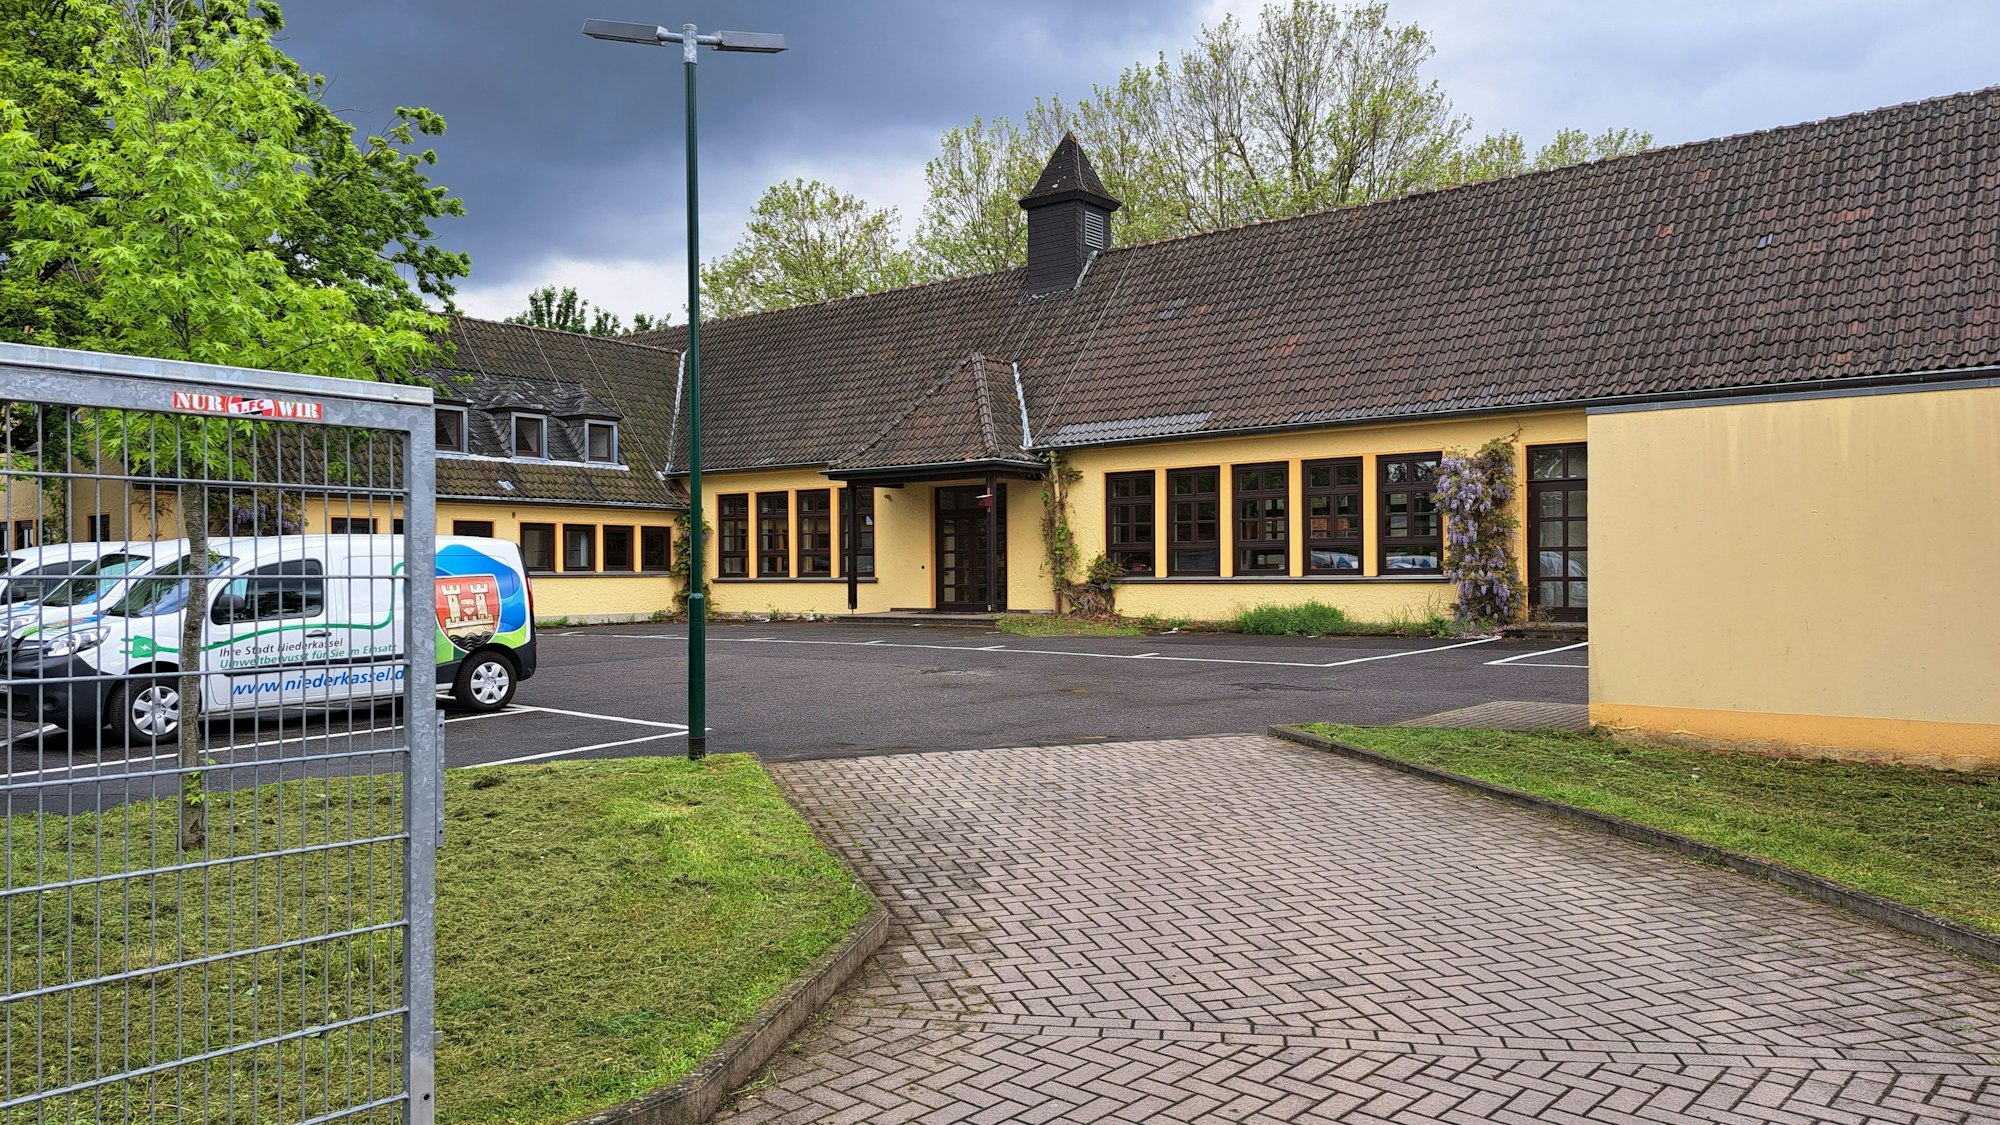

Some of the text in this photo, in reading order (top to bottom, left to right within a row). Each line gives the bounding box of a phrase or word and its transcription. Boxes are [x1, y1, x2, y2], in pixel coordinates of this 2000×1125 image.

[176, 391, 224, 411] NUR
[279, 400, 320, 419] WIR
[219, 647, 242, 658] Ihre
[245, 643, 274, 656] Stadt
[330, 648, 345, 658] Sie
[348, 646, 360, 656] m
